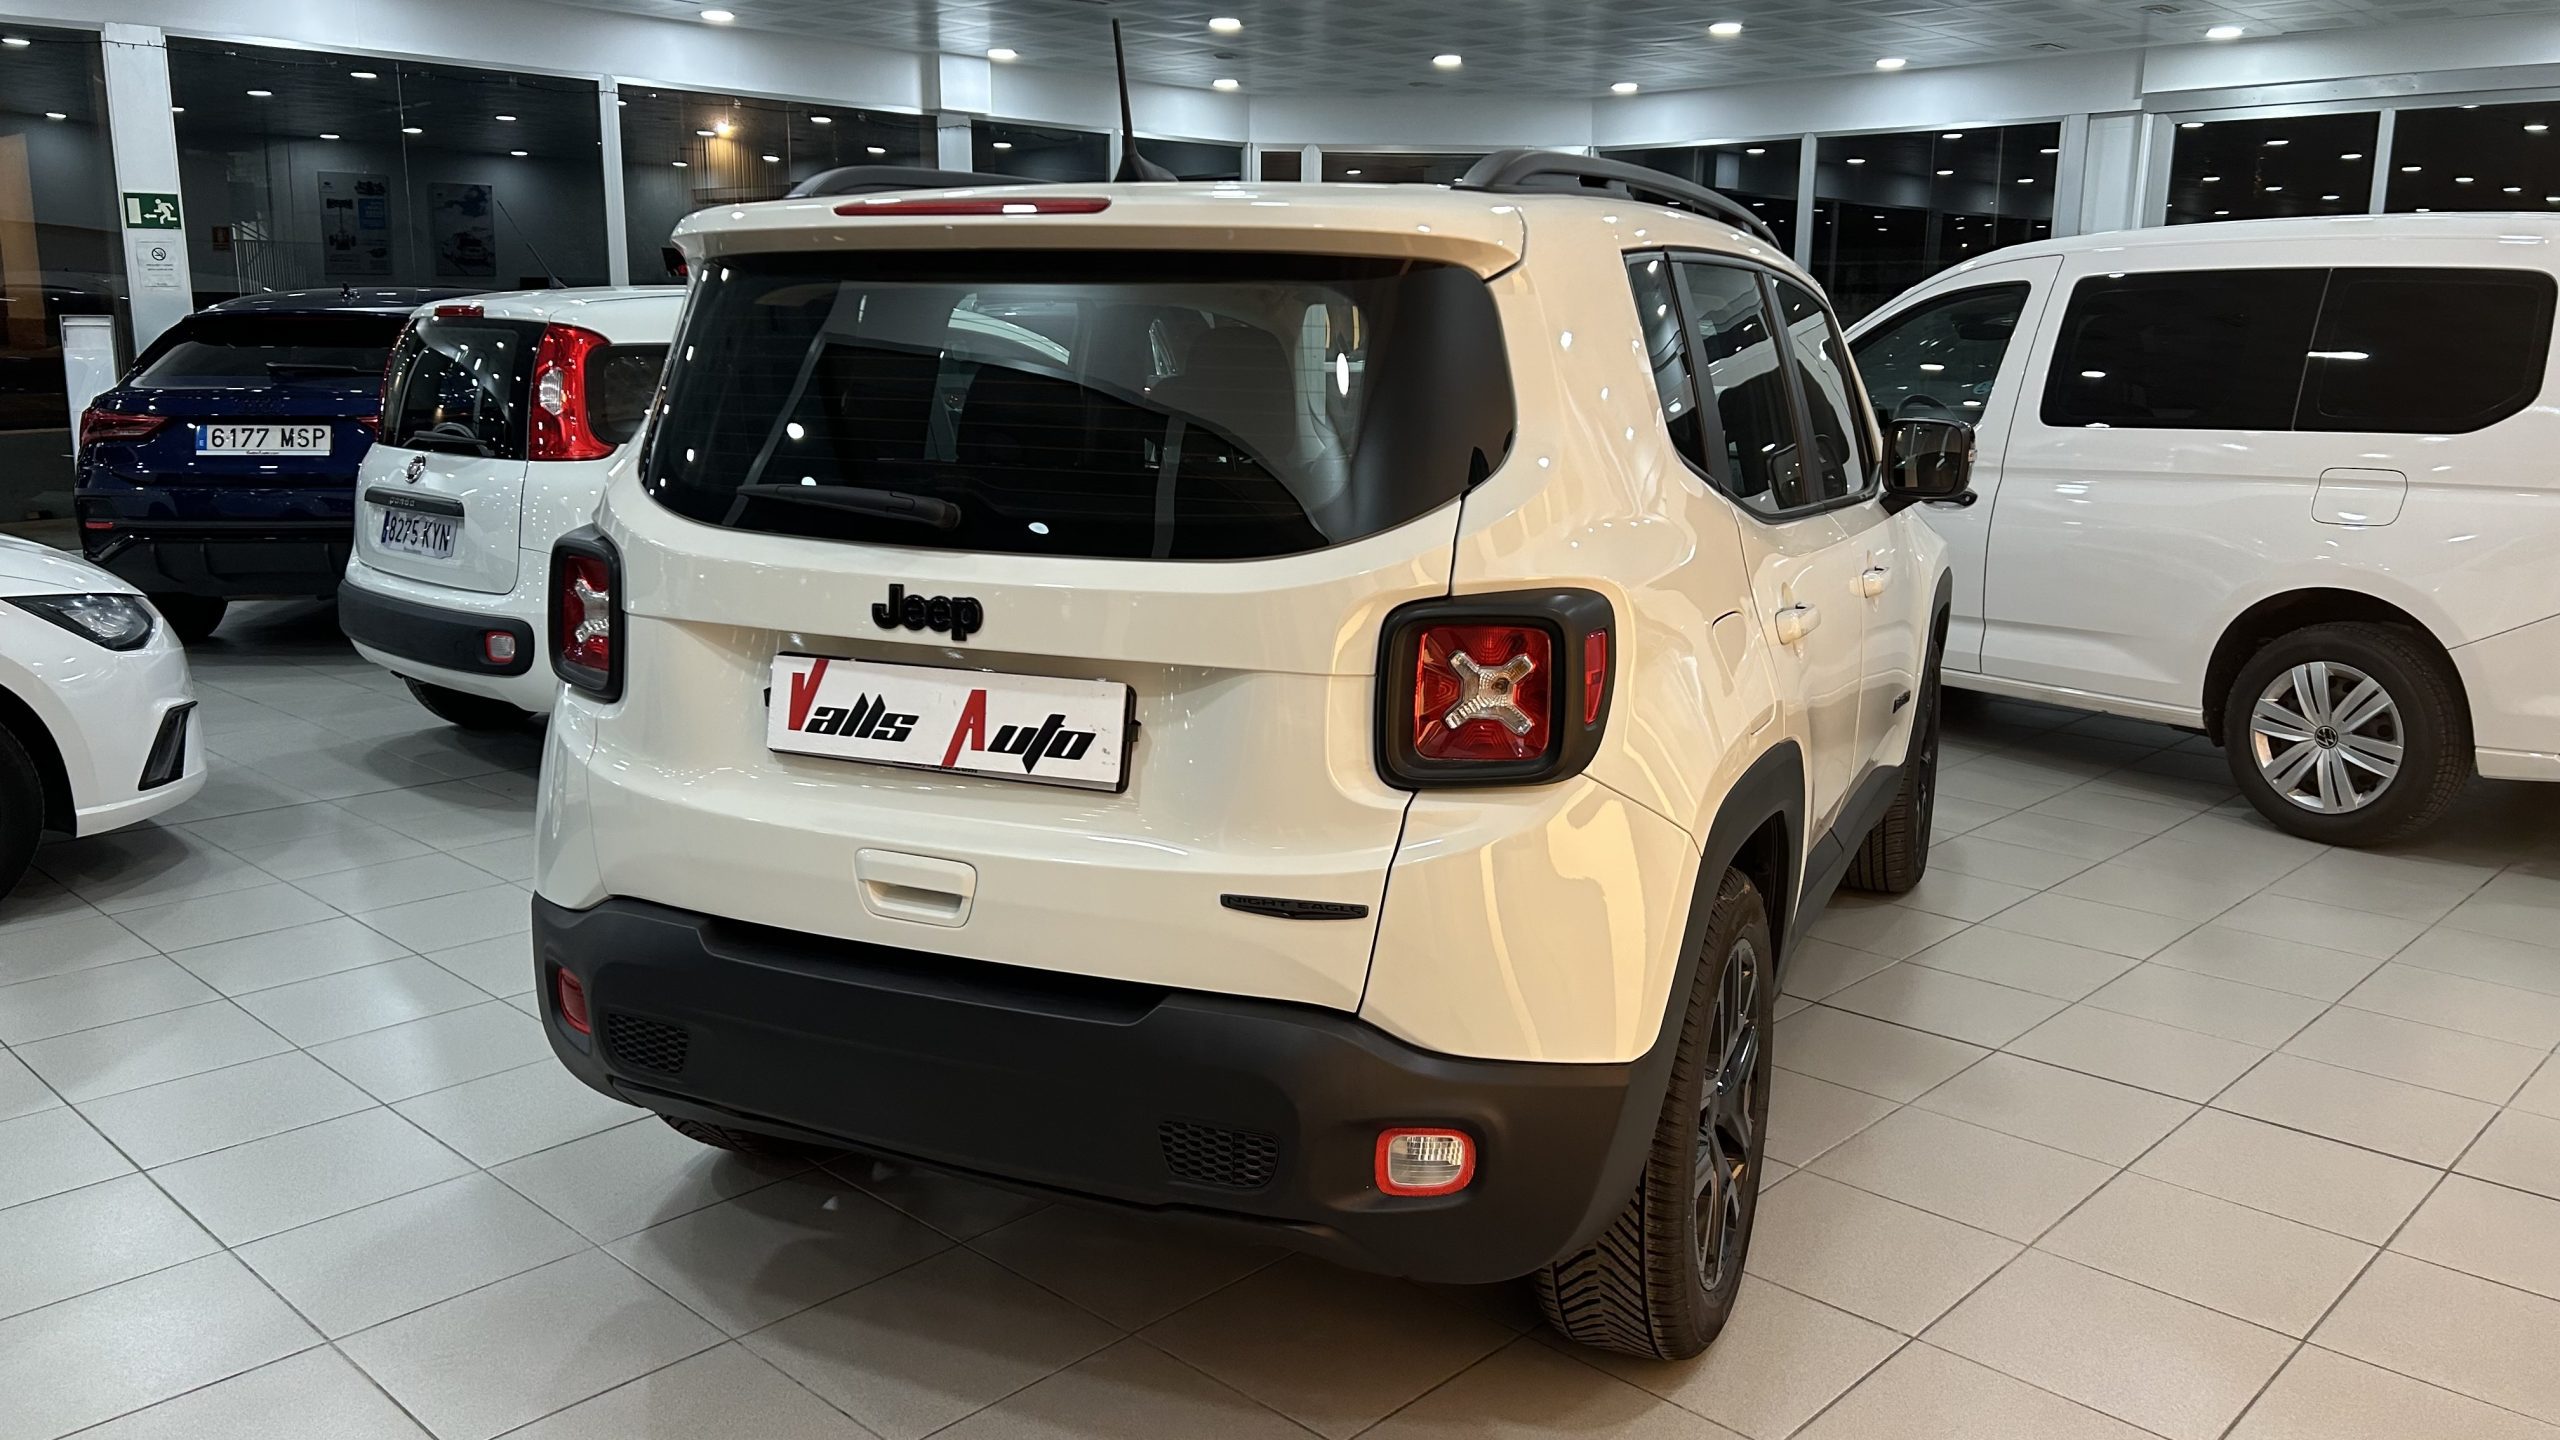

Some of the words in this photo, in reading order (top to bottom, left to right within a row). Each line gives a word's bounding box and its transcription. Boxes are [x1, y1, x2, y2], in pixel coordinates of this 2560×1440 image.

[211, 428, 269, 448] 6177
[280, 428, 325, 448] MSP
[388, 517, 420, 545] 8275
[421, 521, 451, 552] KYN
[872, 583, 983, 641] Jeep
[788, 659, 920, 743] Valls
[940, 689, 1097, 774] Auto
[1227, 896, 1290, 908] NIGHT
[1297, 902, 1366, 915] EAGLE
